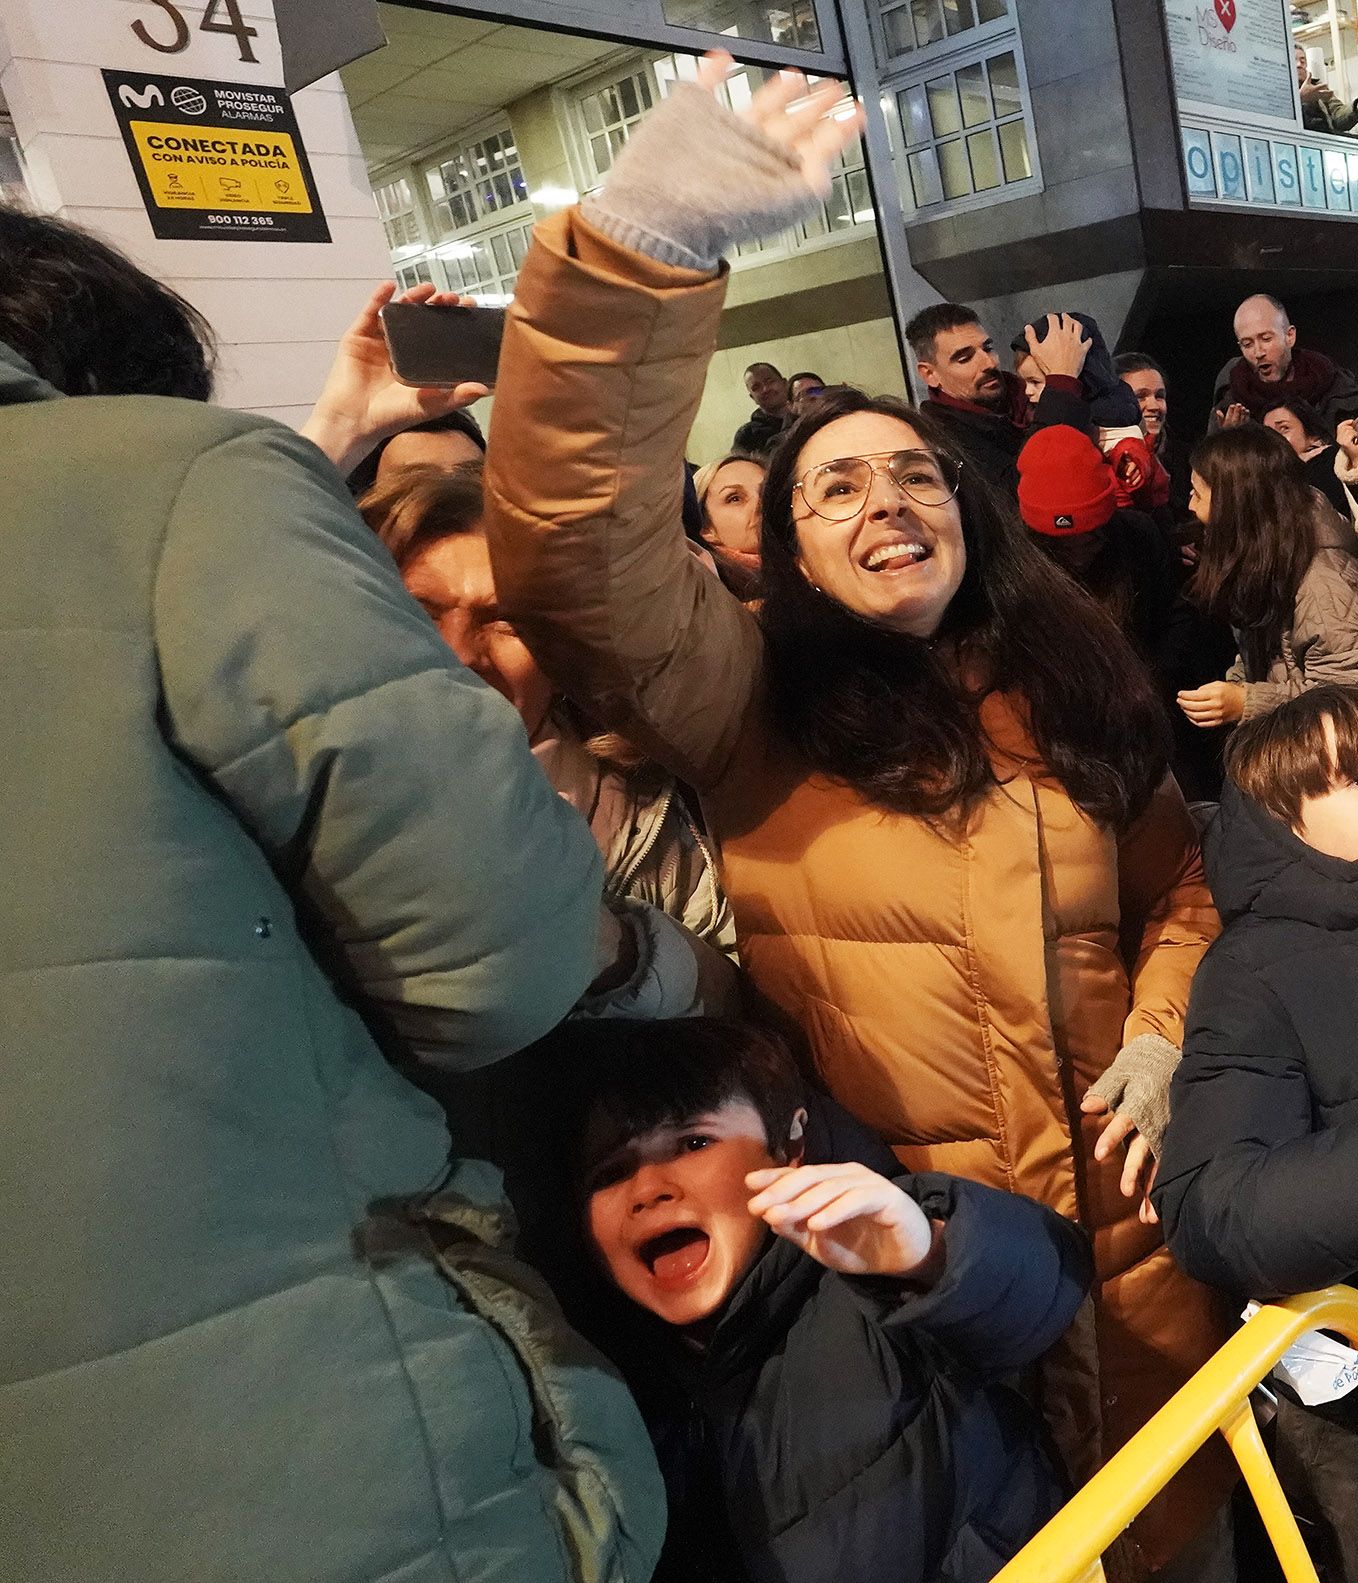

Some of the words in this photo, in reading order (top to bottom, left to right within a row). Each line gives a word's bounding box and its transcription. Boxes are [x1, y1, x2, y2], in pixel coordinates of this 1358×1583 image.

[214, 90, 276, 103] MOVISTAR
[217, 100, 285, 114] PROSEGUR
[221, 110, 274, 123] ALARMAS
[147, 136, 287, 158] CONECTADA
[152, 153, 183, 163] CON
[187, 154, 227, 165] AVISO
[230, 158, 240, 167] A
[242, 158, 290, 170] POLICÍA
[207, 215, 231, 224] 900
[232, 216, 250, 225] 112
[251, 216, 274, 226] 365
